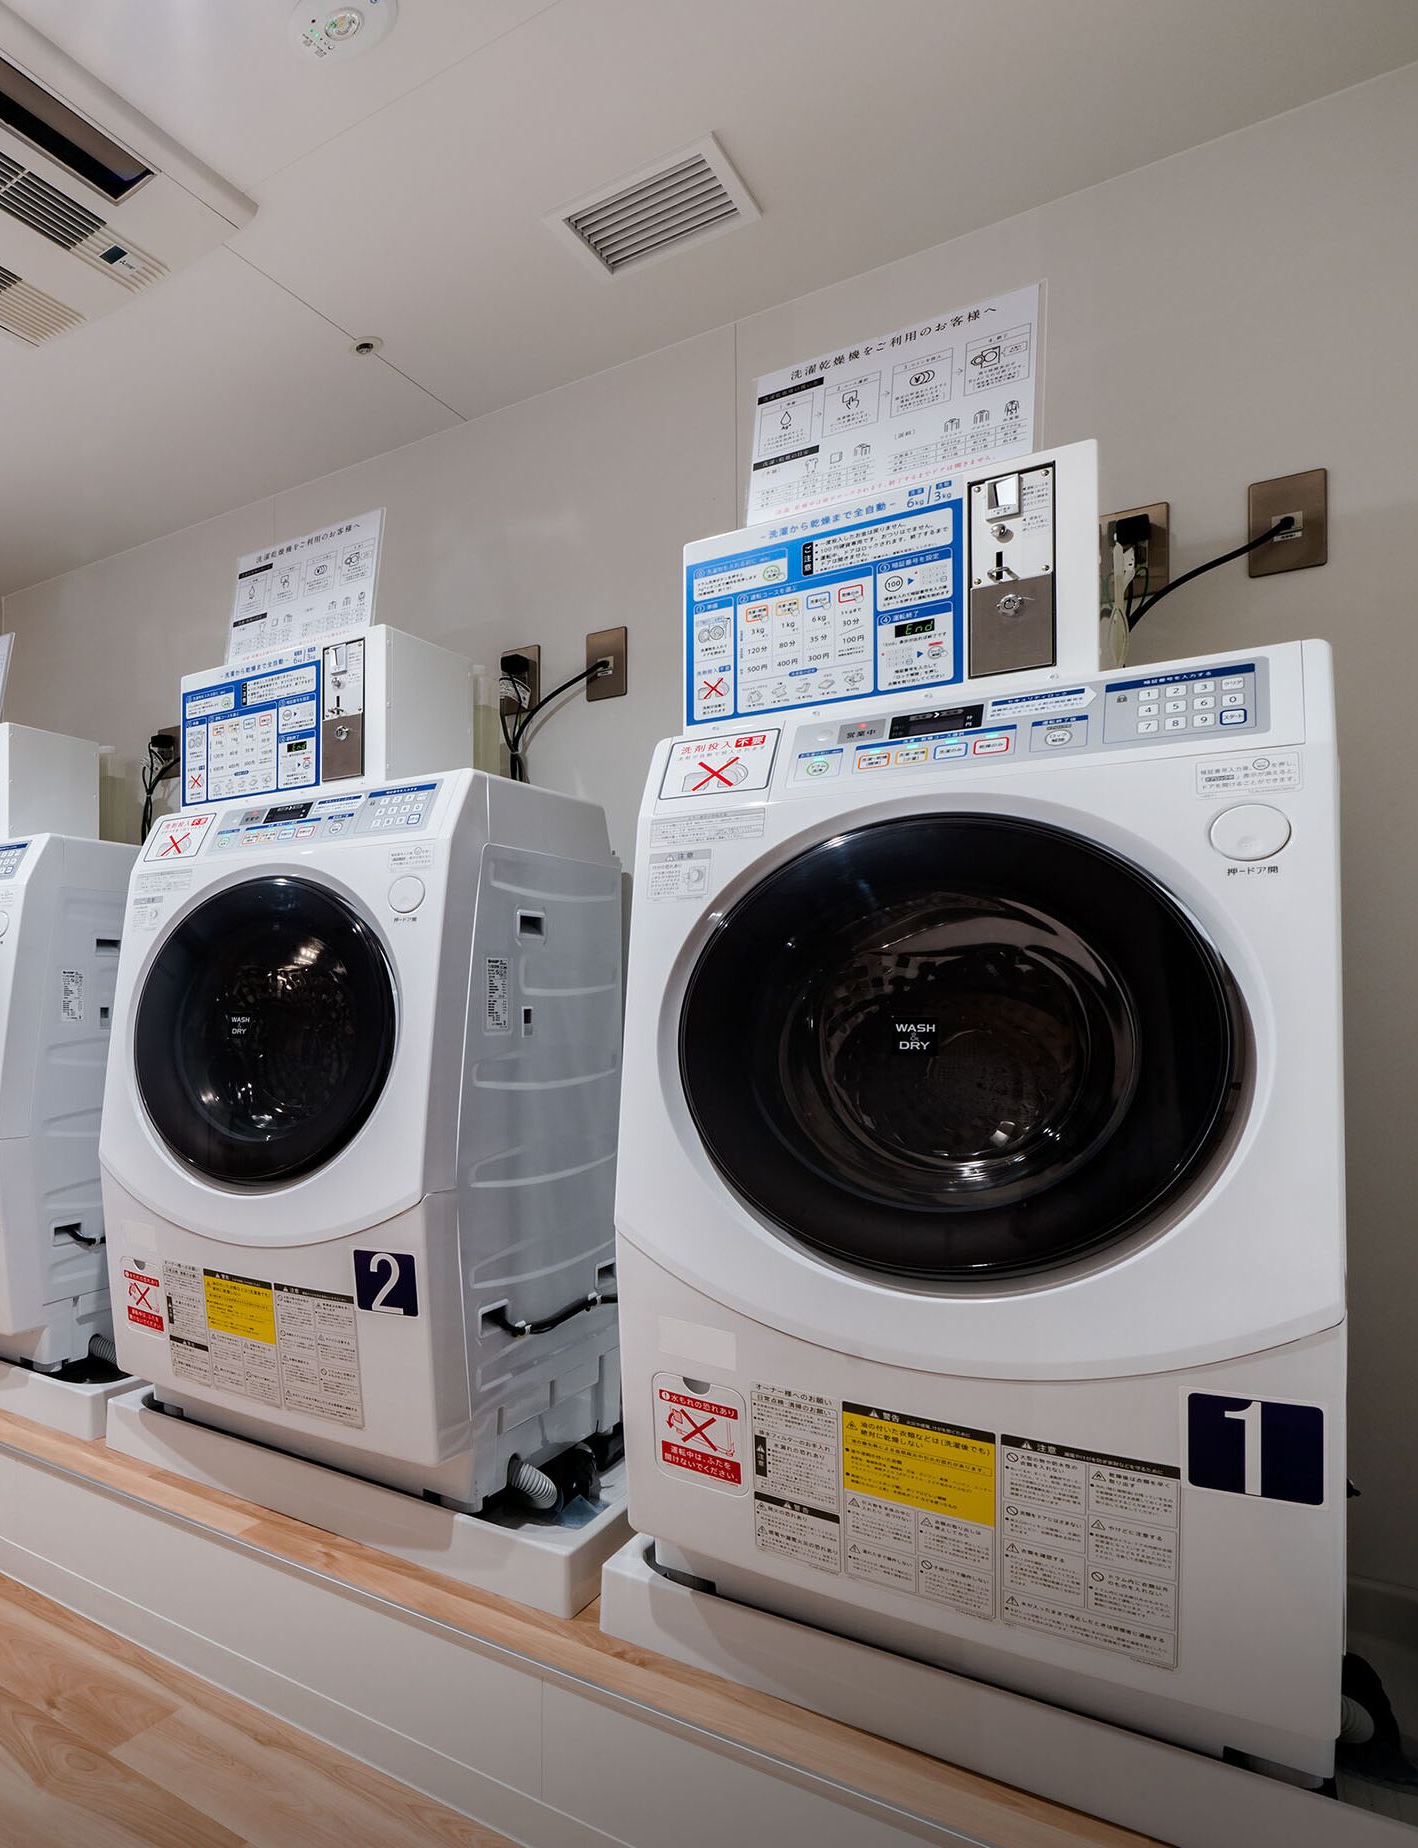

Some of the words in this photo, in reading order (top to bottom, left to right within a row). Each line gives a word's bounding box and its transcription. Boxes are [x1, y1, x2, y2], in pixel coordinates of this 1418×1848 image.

[789, 307, 997, 381] 洗濯乾燥機をご利用のお客様へ
[768, 500, 886, 539] 洗濯から乾燥まで全自動
[887, 579, 900, 588] 100
[905, 620, 934, 636] End
[1144, 722, 1151, 730] 7
[680, 739, 733, 755] 洗剤投入
[736, 735, 765, 748] 不要
[895, 1023, 936, 1032] WASH
[910, 1032, 920, 1041] &
[899, 1041, 930, 1050] DRY
[369, 1252, 404, 1315] 2
[670, 1394, 736, 1417] 水もれの恐れあり
[860, 1429, 924, 1449] 絶対に乾燥しない
[1036, 1443, 1058, 1455] 注意
[1223, 1400, 1262, 1497] 1
[664, 1452, 739, 1482] 開けないでください。
[670, 1445, 732, 1471] 運転中は、ふたを
